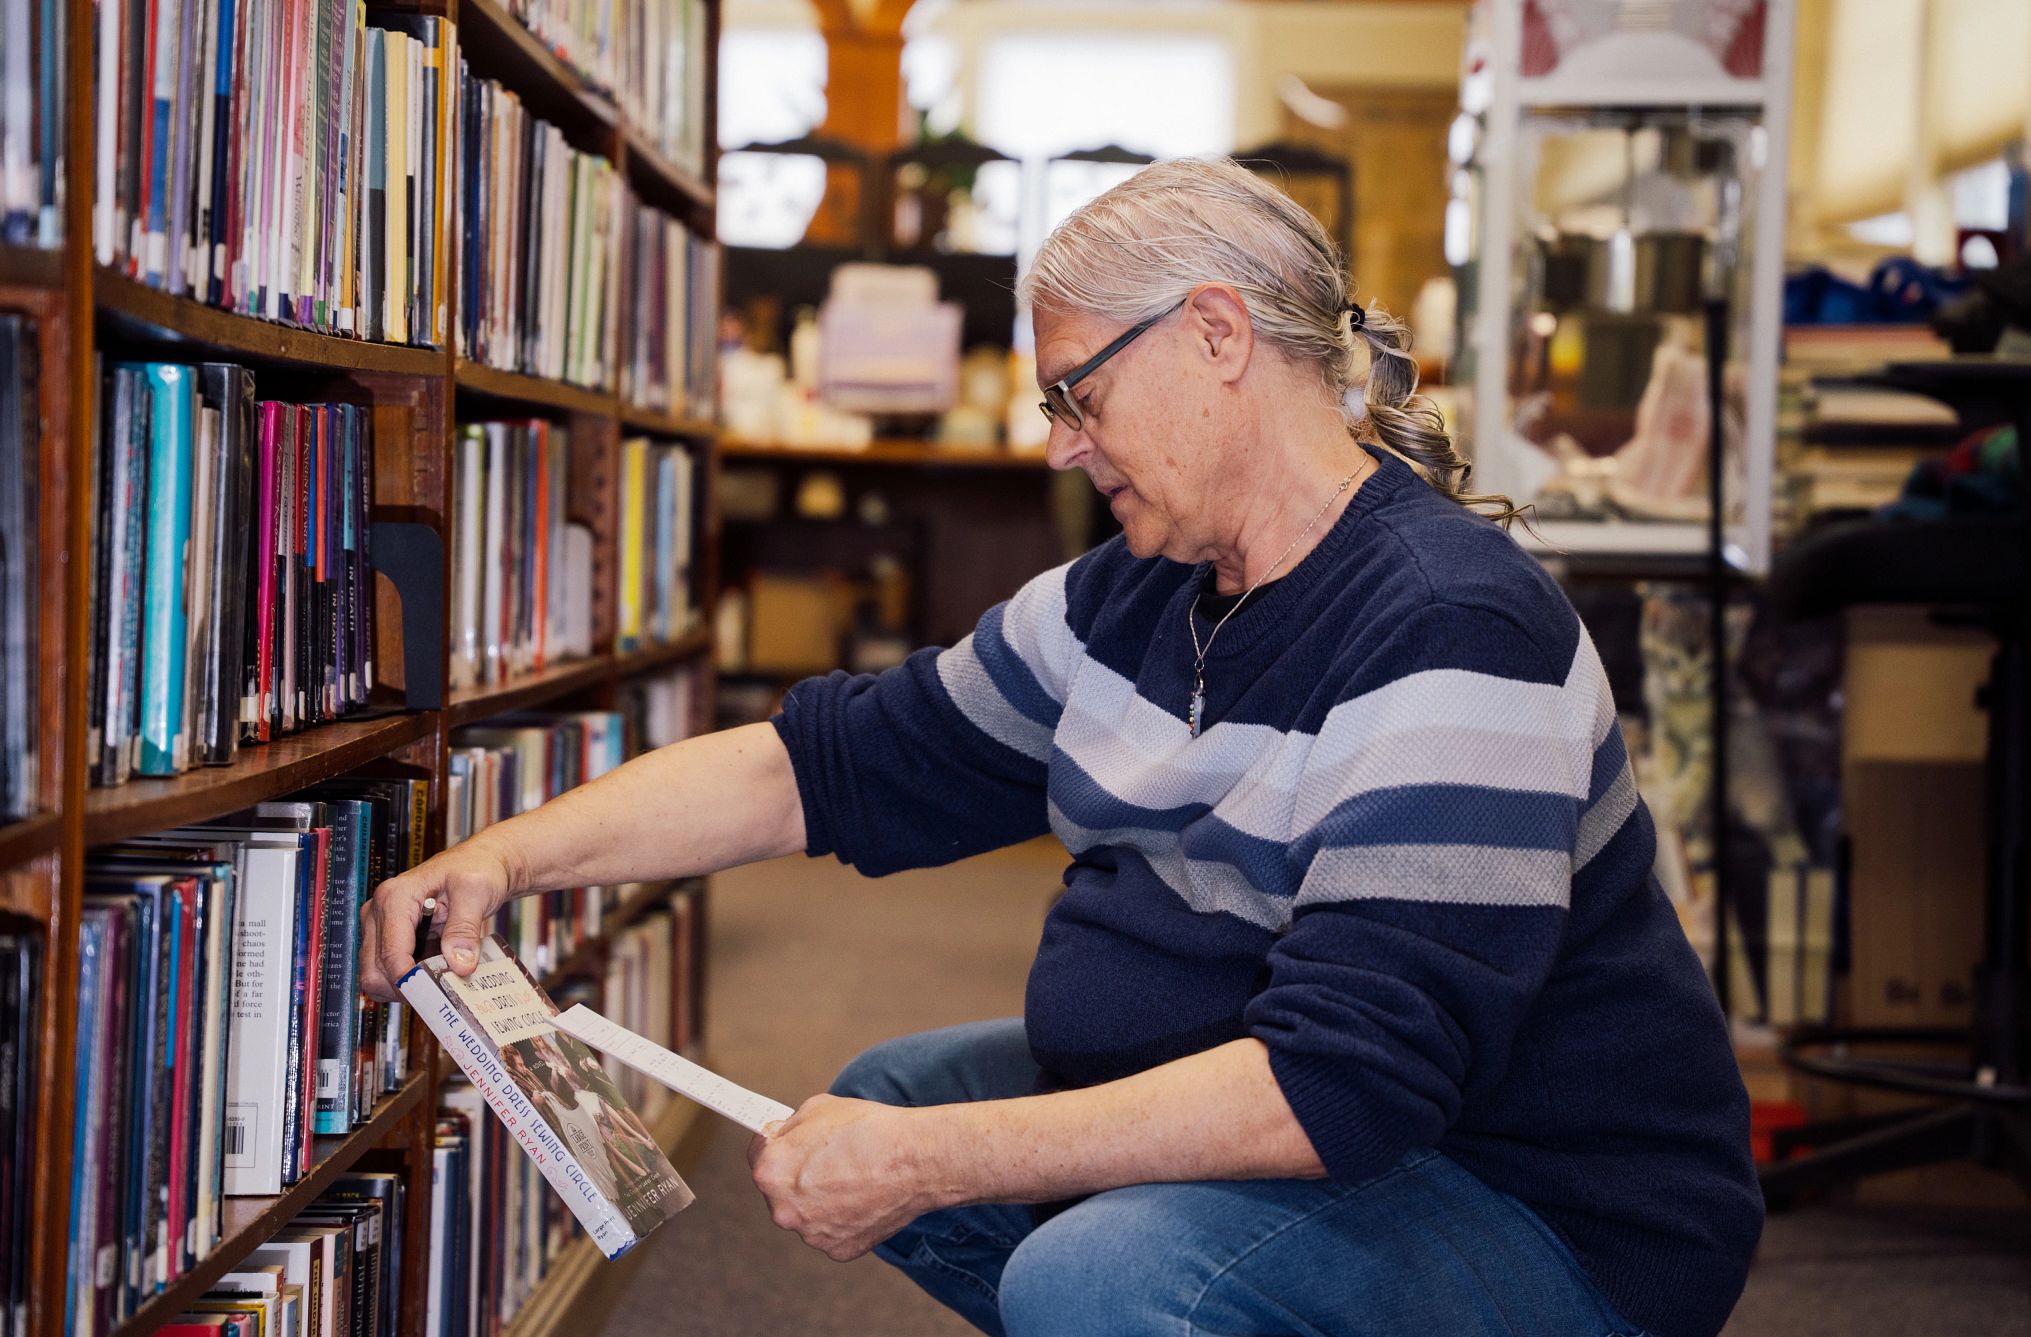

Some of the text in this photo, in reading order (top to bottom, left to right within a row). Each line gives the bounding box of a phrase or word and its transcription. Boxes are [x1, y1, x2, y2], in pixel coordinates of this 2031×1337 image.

[349, 565, 355, 581] IN
[332, 593, 337, 606] IN
[336, 887, 345, 895] be
[248, 919, 266, 927] mall
[240, 929, 266, 937] shoot-
[242, 939, 265, 947] chaos
[331, 951, 343, 959] has
[249, 959, 265, 968] had
[246, 969, 265, 978] oth-
[315, 943, 324, 1014] ROBERTS
[463, 971, 516, 993] THE WEDDING
[235, 979, 264, 988] But for
[330, 982, 341, 990] the
[251, 990, 263, 998] far
[241, 999, 263, 1008] force
[491, 993, 518, 1010] DRESS
[237, 1010, 262, 1018] test in
[490, 1010, 545, 1035] SEWING CIRCLE
[438, 1003, 598, 1203] THE WEDDING DRESS SEWING CIRCLE
[463, 1063, 547, 1165] JENNIFER RYAN
[624, 1188, 661, 1221] JENNIFER
[657, 1175, 680, 1197] RYAN
